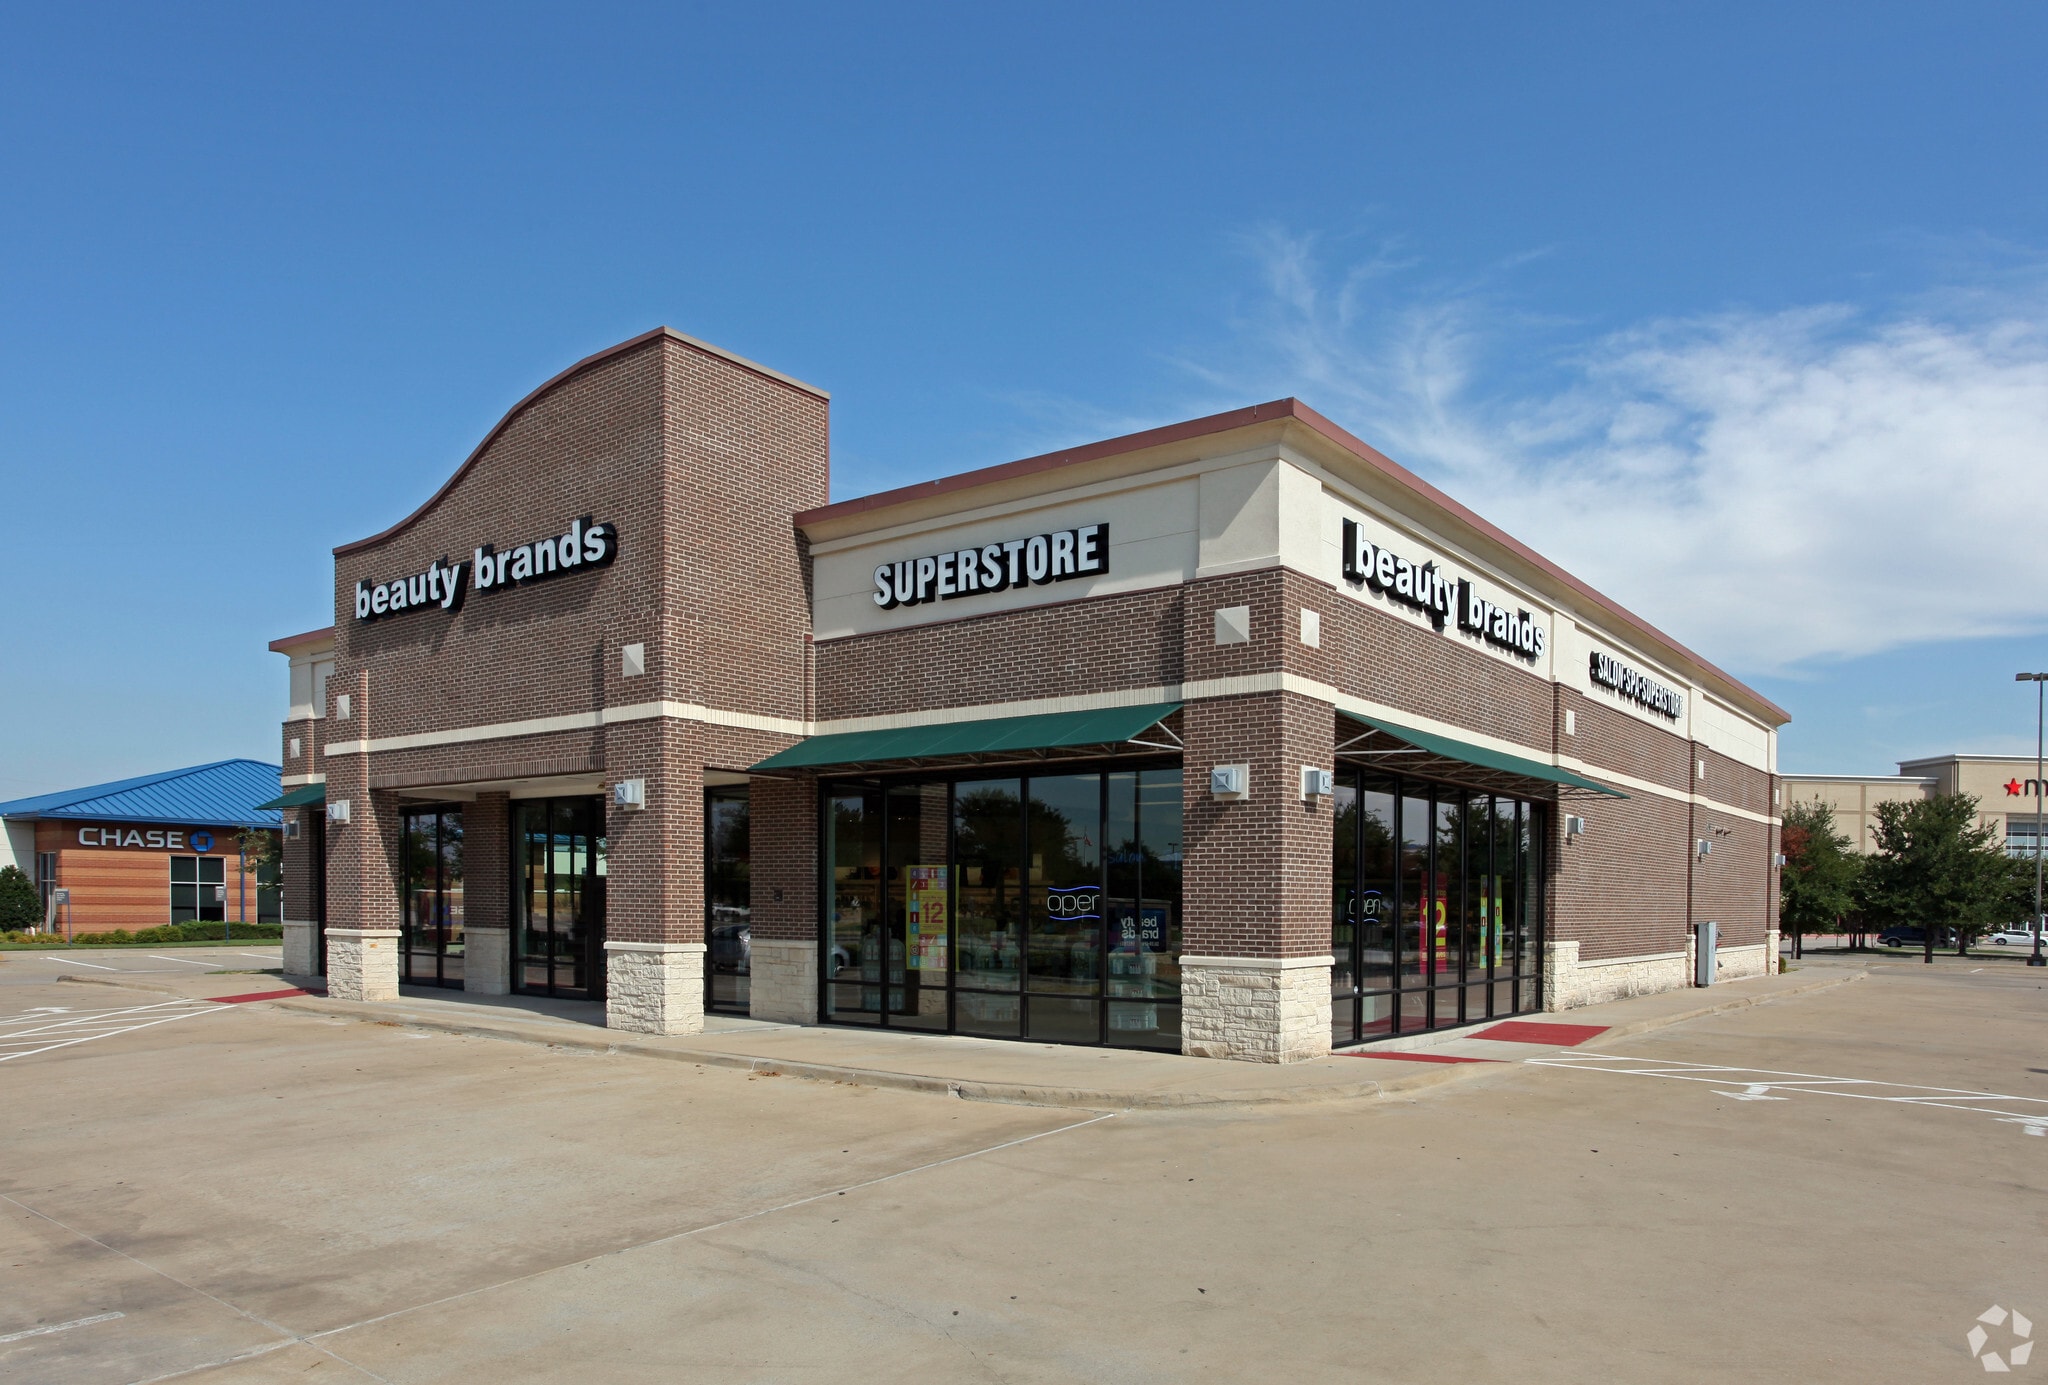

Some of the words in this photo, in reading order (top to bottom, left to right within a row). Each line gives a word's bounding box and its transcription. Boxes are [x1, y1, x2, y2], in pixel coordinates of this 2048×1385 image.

[355, 559, 462, 619] beauty
[474, 519, 608, 589] brands
[872, 524, 1102, 607] SUPERSTORE
[1356, 522, 1458, 626] beauty
[1468, 581, 1546, 657] brands
[78, 827, 185, 849] CHASE
[923, 902, 944, 923] 12
